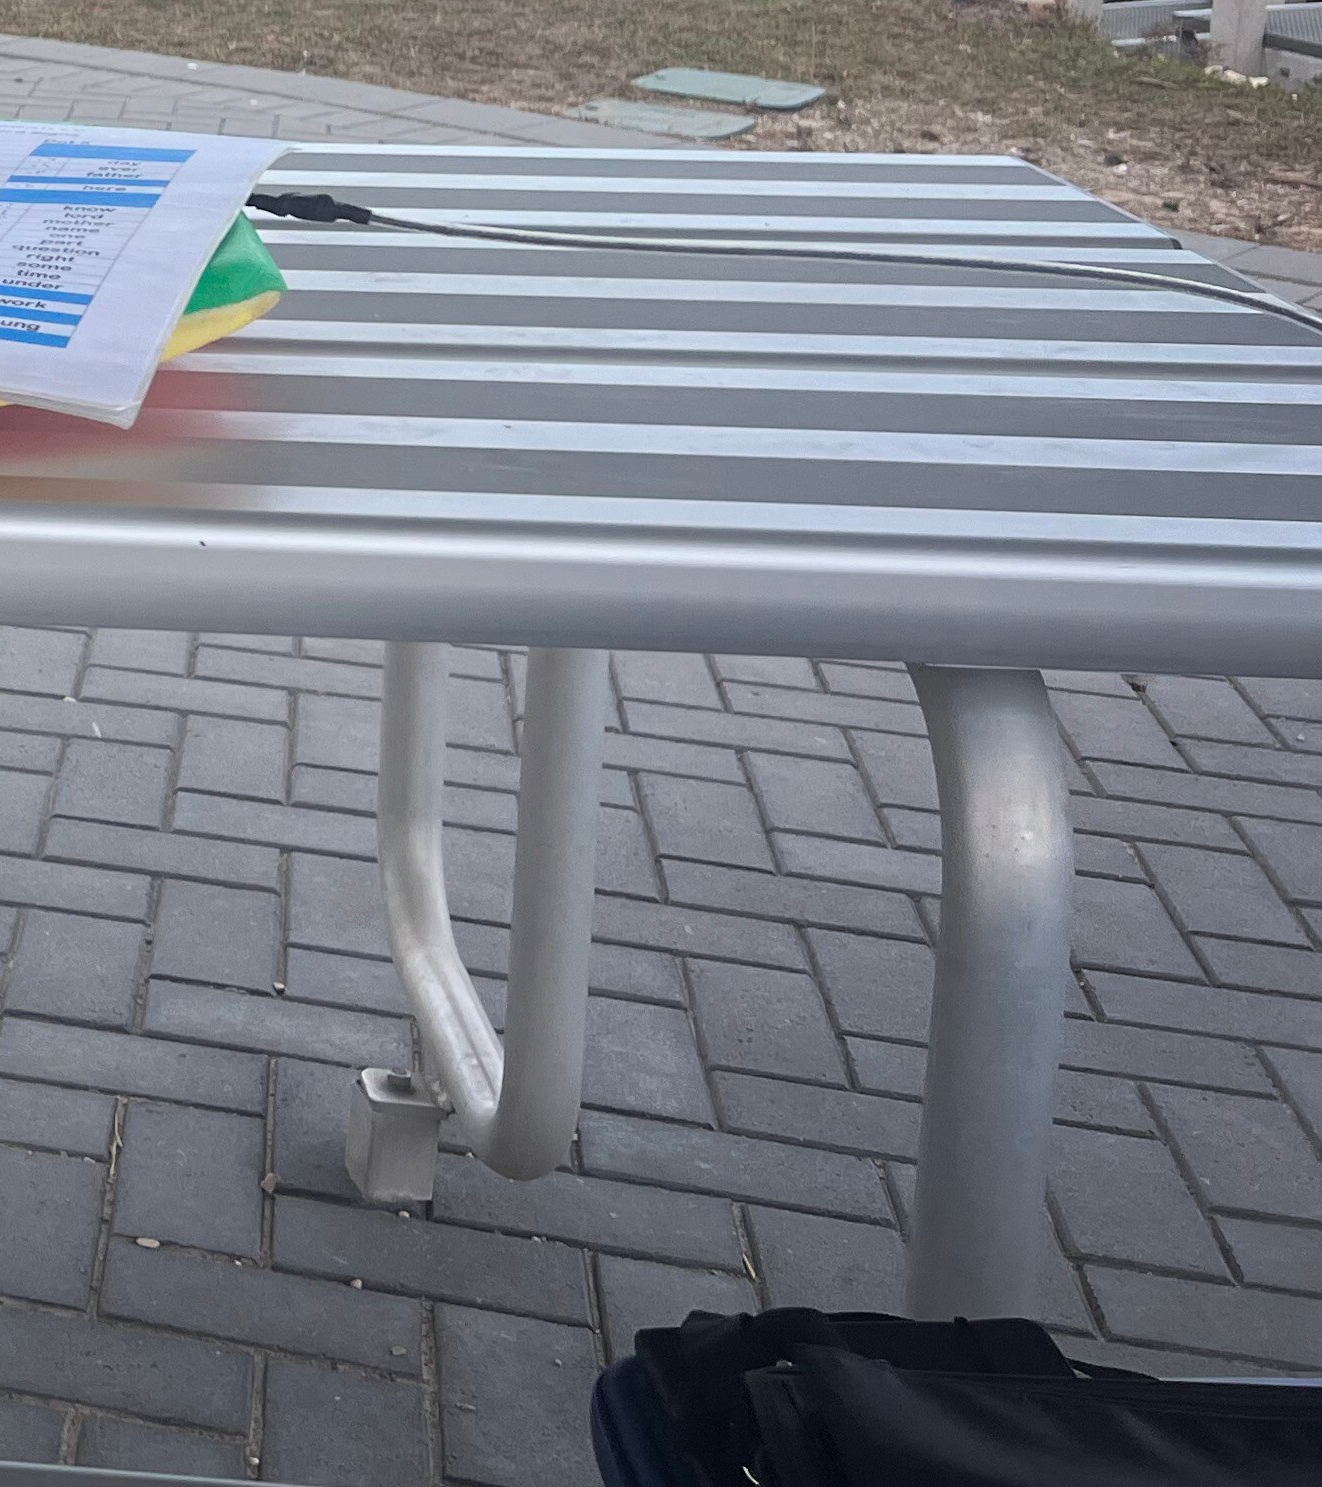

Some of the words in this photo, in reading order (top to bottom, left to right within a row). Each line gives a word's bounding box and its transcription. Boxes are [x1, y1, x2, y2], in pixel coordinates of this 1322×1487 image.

[63, 205, 118, 213] know
[42, 219, 115, 227] mother
[11, 244, 100, 256] question
[25, 254, 75, 262] right
[17, 262, 73, 271] some
[16, 269, 61, 280] time
[2, 278, 65, 290] under
